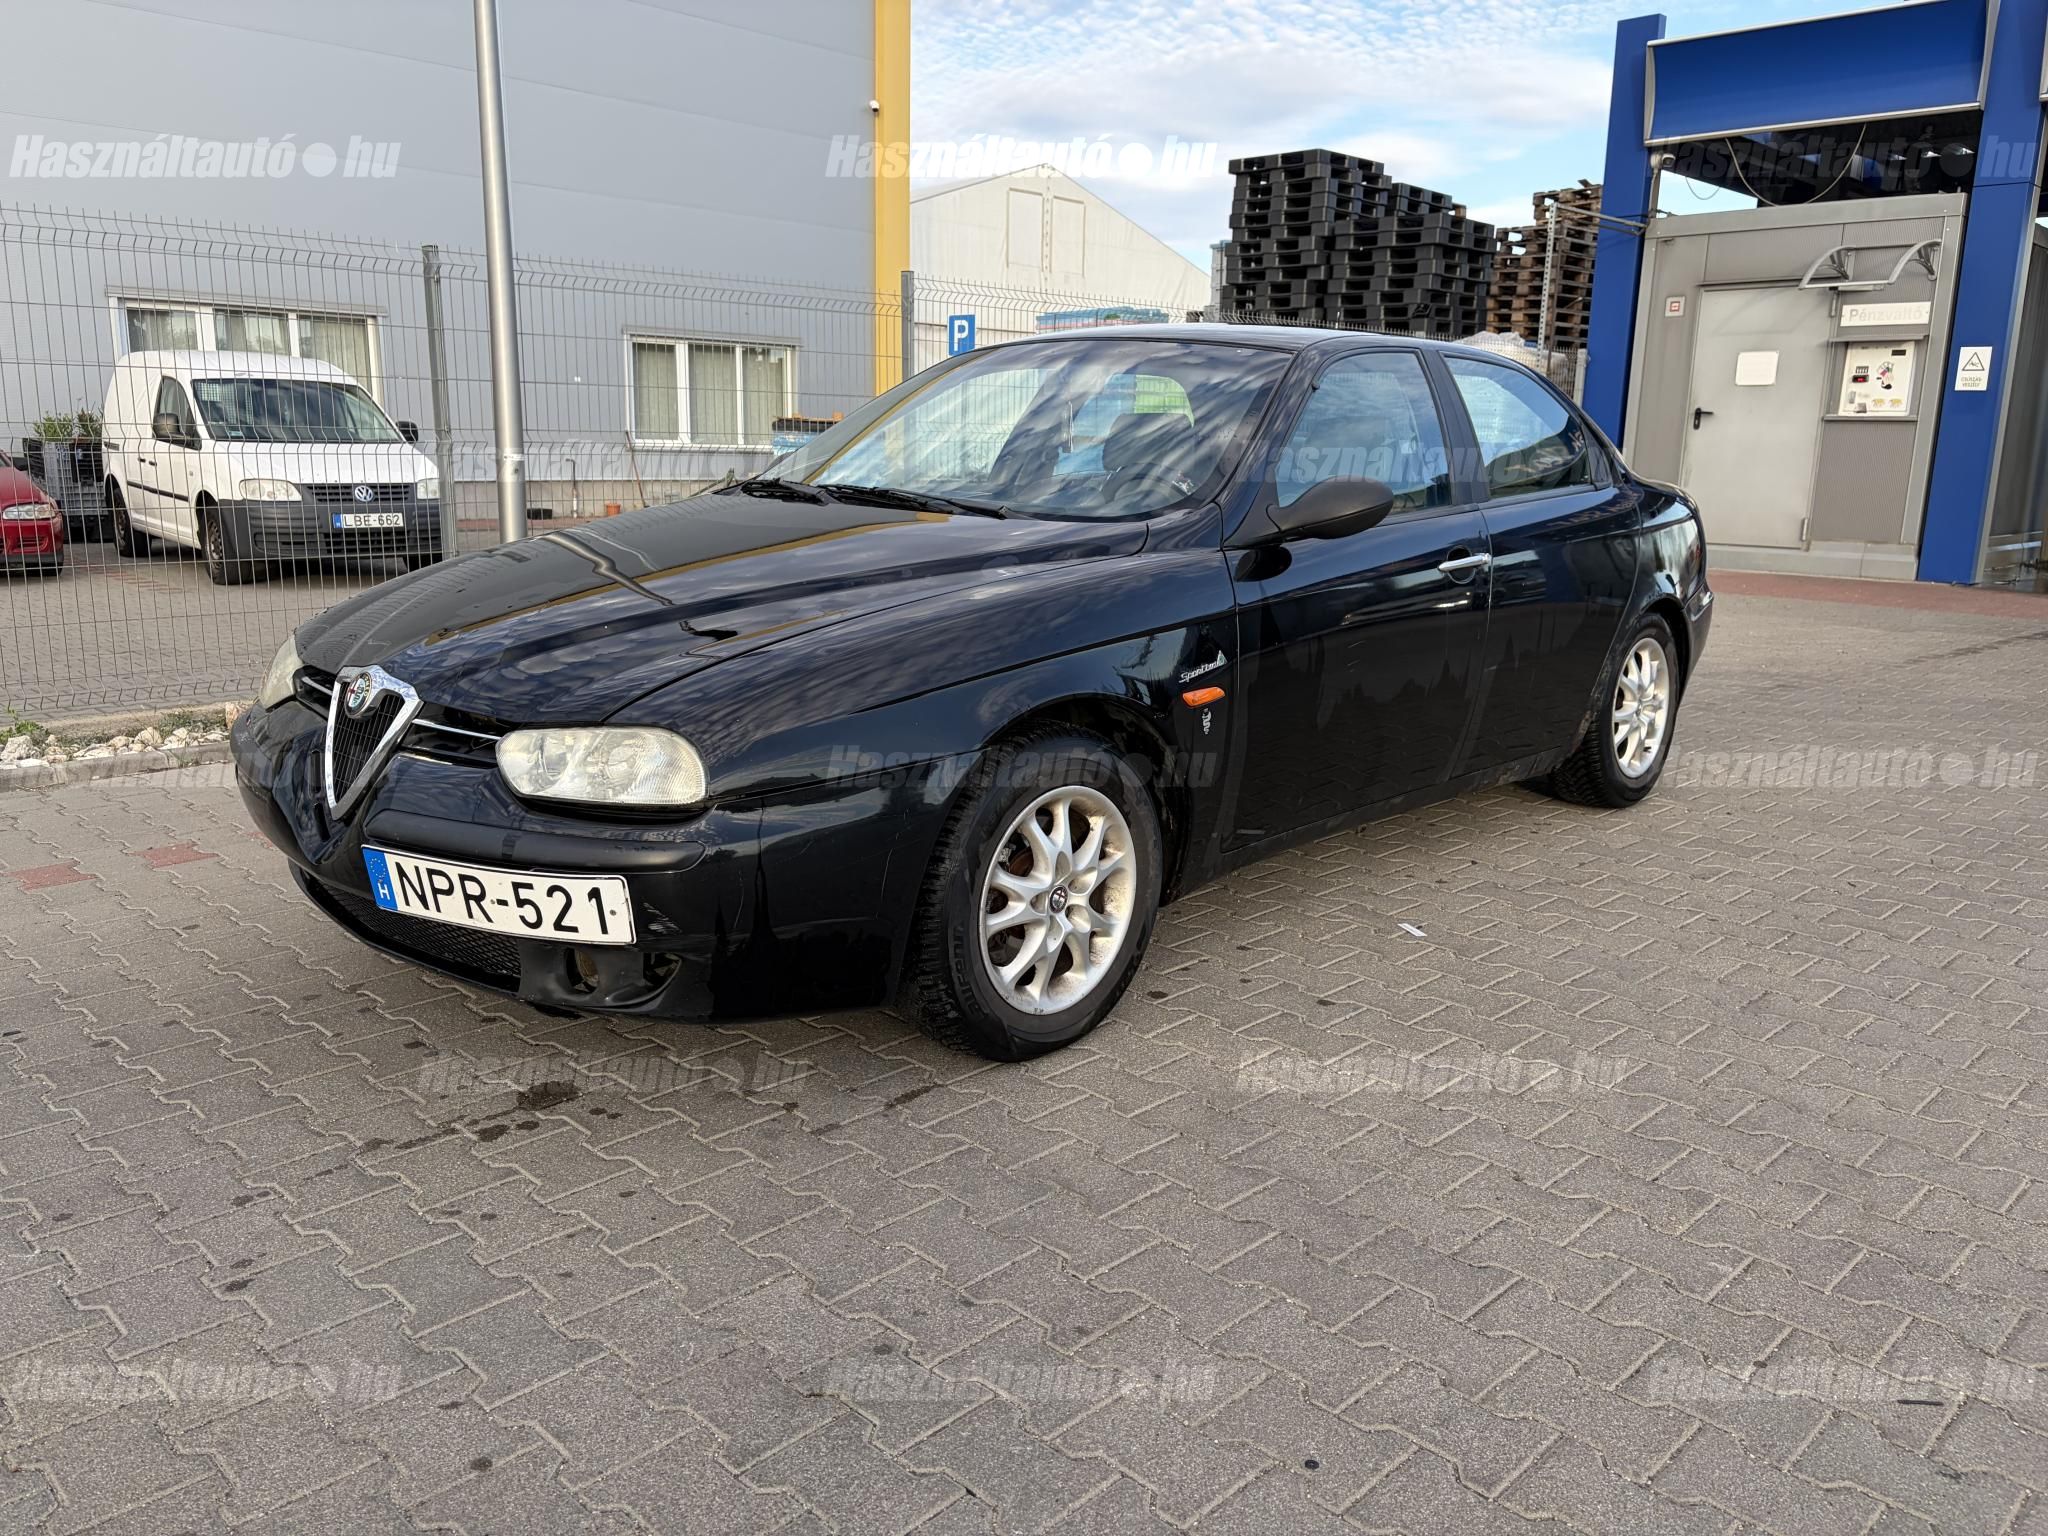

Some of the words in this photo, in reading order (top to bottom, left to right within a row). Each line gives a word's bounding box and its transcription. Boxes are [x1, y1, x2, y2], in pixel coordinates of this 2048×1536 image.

[954, 319, 969, 352] P
[344, 514, 401, 527] LBE-662
[378, 883, 391, 900] H
[395, 861, 609, 935] NPR-521
